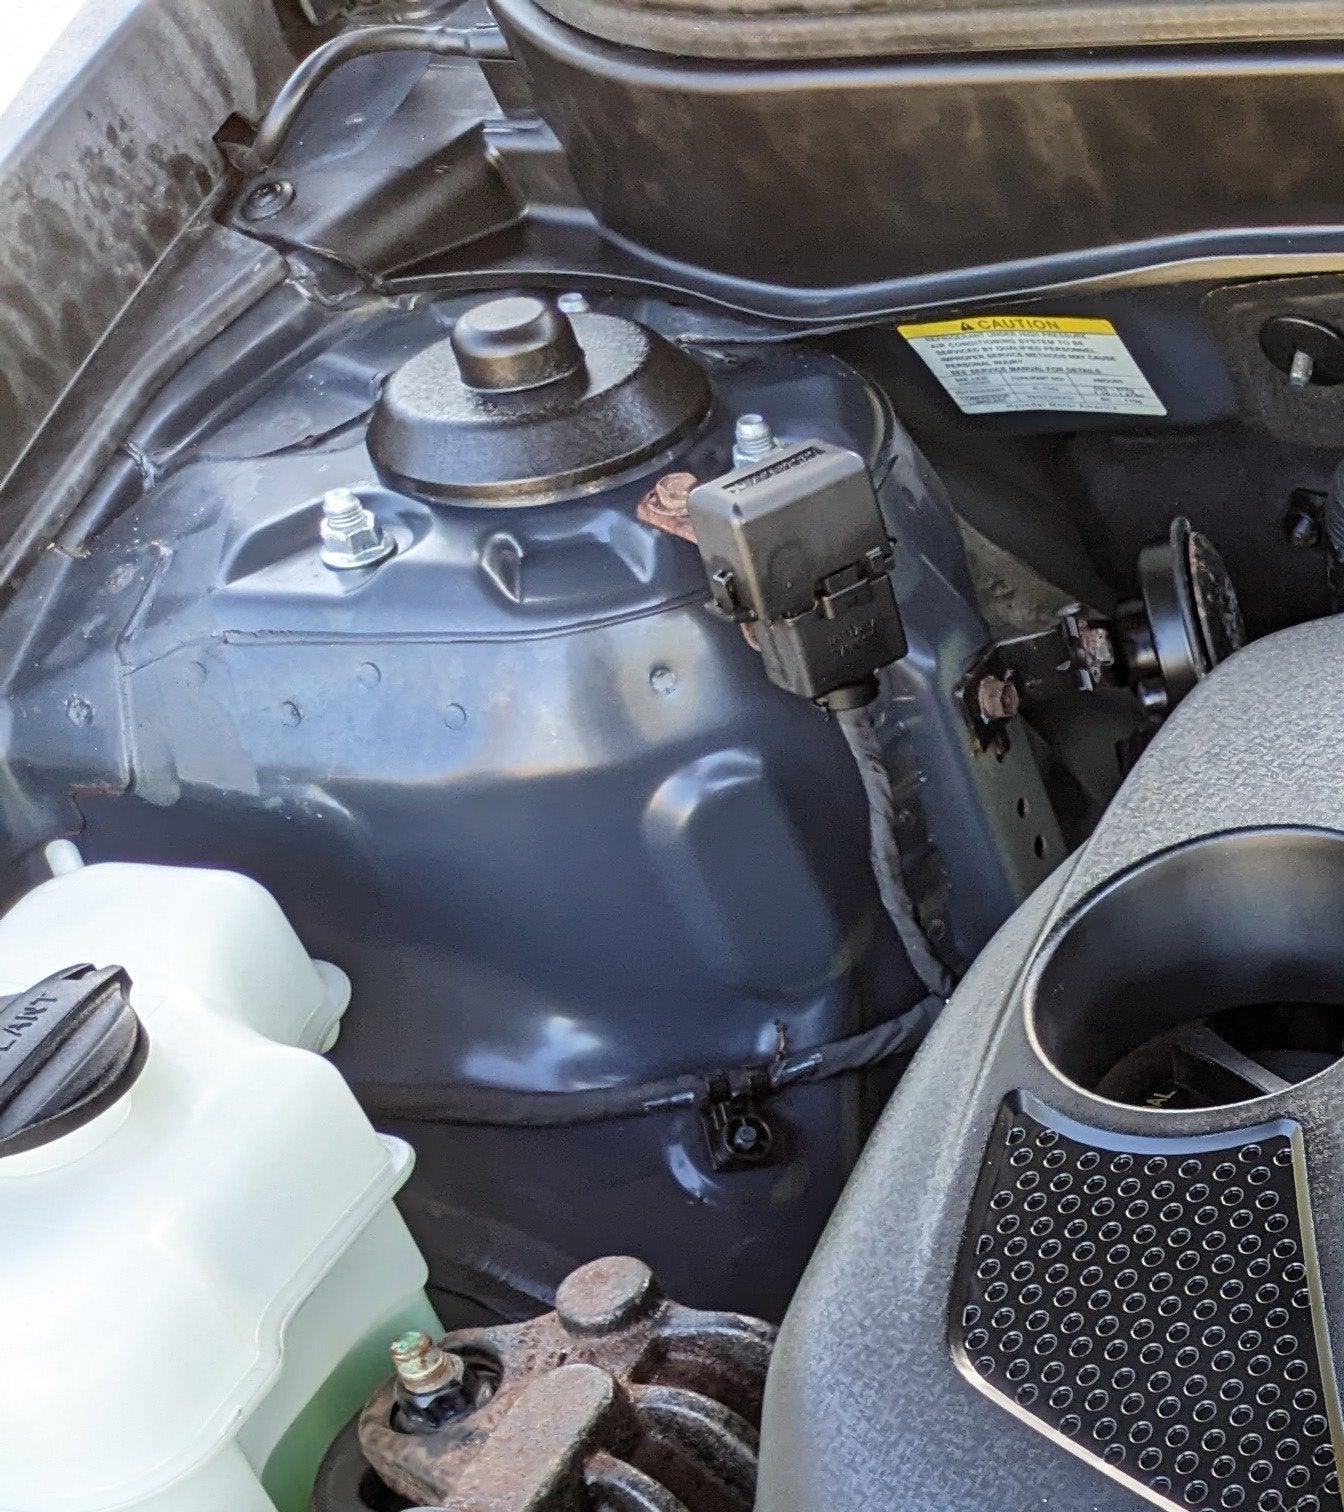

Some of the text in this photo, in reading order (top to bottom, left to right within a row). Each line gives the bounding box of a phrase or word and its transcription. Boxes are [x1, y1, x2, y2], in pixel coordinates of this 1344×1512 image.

[978, 319, 1060, 330] CAUTION
[948, 338, 1015, 347] CONDITIONING
[996, 345, 1042, 353] QUALIFIED
[941, 353, 985, 362] IMPROPER
[1088, 354, 1117, 362] CAUSE
[945, 361, 990, 369] PERSONAL
[950, 369, 967, 377] SEE
[969, 366, 1007, 375] SERVICE
[1008, 365, 1045, 373] MANUAL
[1046, 366, 1064, 374] FOR
